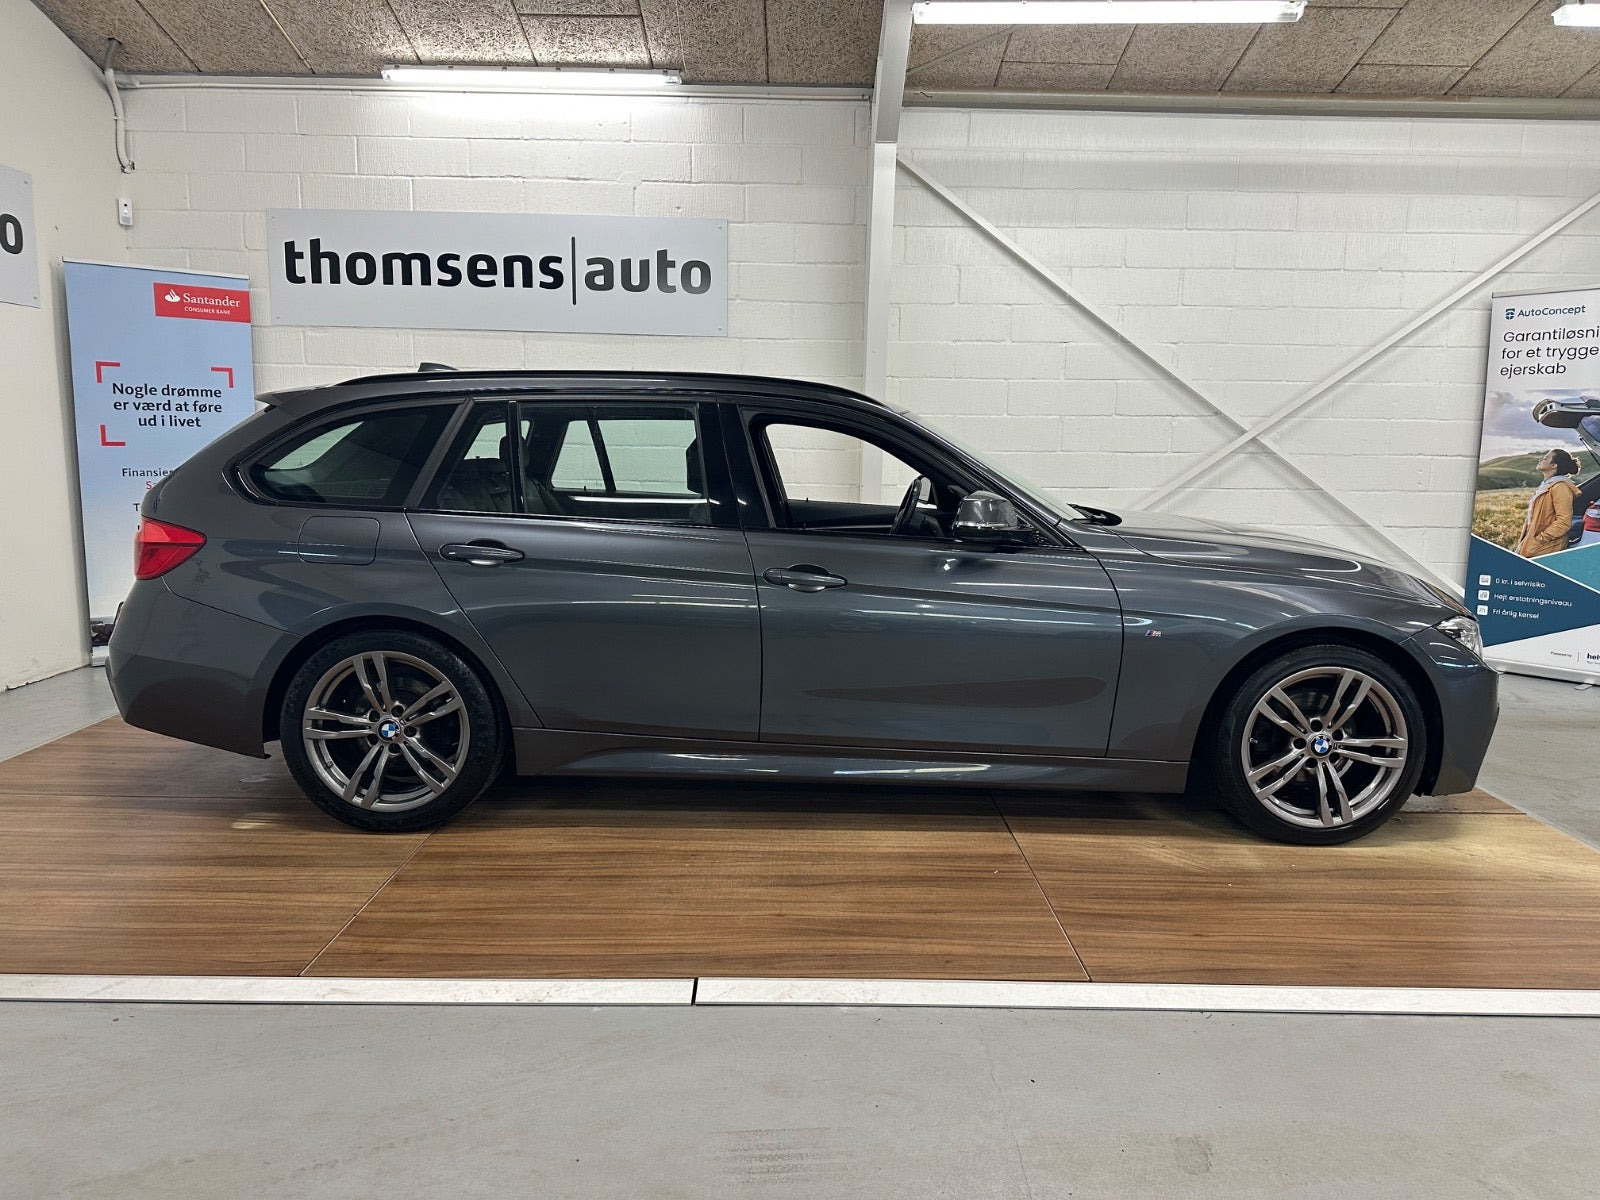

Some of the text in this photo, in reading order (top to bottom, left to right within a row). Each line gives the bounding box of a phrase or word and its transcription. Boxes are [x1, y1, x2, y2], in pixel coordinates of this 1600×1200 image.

[182, 292, 241, 307] Santander
[184, 306, 215, 314] CONSUMER
[1517, 304, 1586, 318] AutoConcept
[1503, 325, 1600, 342] Garantiløsni
[1501, 345, 1600, 360] for et trygge
[1500, 362, 1567, 379] ejerskab
[112, 382, 222, 399] Nogle drømme
[113, 399, 222, 413] er værd at føre
[138, 414, 202, 428] ud i livet
[1513, 579, 1546, 588] selvrisiko
